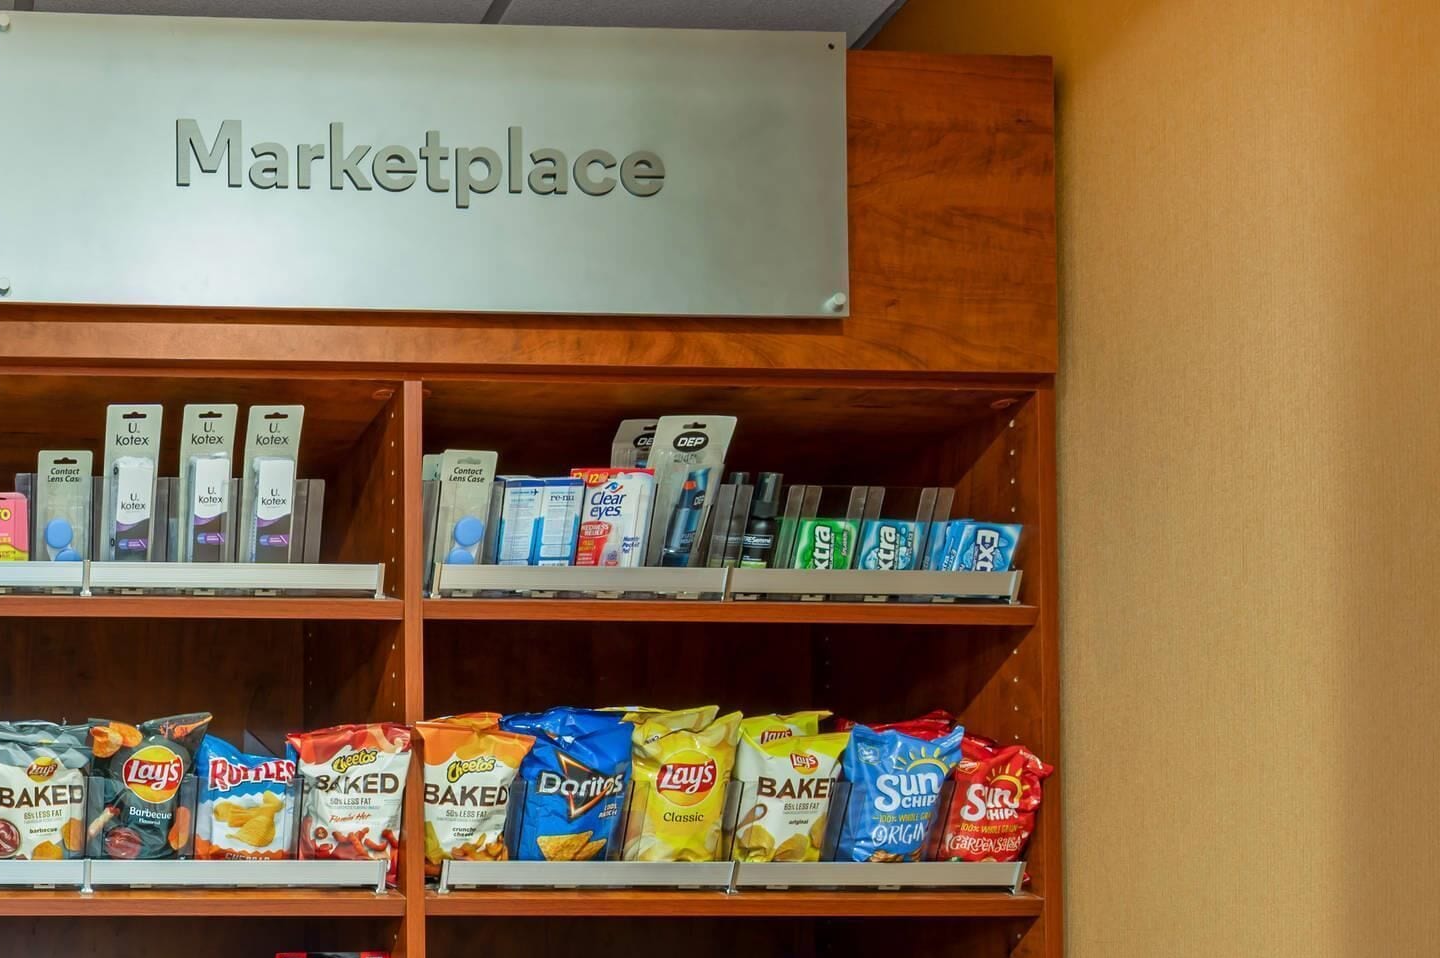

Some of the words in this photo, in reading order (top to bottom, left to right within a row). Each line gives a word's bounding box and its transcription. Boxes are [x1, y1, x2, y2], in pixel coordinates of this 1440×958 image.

[174, 117, 667, 208] Marketplace
[116, 434, 150, 446] kotex
[191, 433, 224, 445] kotex
[256, 433, 288, 446] kotex
[677, 437, 705, 447] DEP
[454, 467, 483, 475] Contact
[48, 475, 63, 483] Lens
[449, 475, 466, 483] Lens
[467, 475, 485, 483] Case
[121, 500, 146, 511] kotex
[198, 494, 223, 505] kotex
[261, 496, 286, 506] kotex
[591, 492, 627, 507] Clear
[590, 506, 622, 520] eyes
[814, 525, 833, 569] xtra
[877, 525, 897, 570] xtra
[332, 750, 377, 773] Cheetos
[128, 760, 180, 790] Lay's
[447, 757, 496, 783] Cheetos
[660, 760, 713, 793] Lay's
[315, 773, 399, 794] BAKED
[539, 772, 624, 797] Doritos
[424, 782, 508, 807] BAKED
[875, 772, 939, 812] Sun
[344, 797, 359, 805] LESS
[360, 797, 371, 805] FAT
[961, 783, 1019, 821] Sun
[35, 811, 51, 819] LESS
[51, 810, 63, 818] FAT
[130, 806, 172, 820] Barbecue
[663, 811, 704, 823] Classic
[29, 826, 58, 834] barbecue
